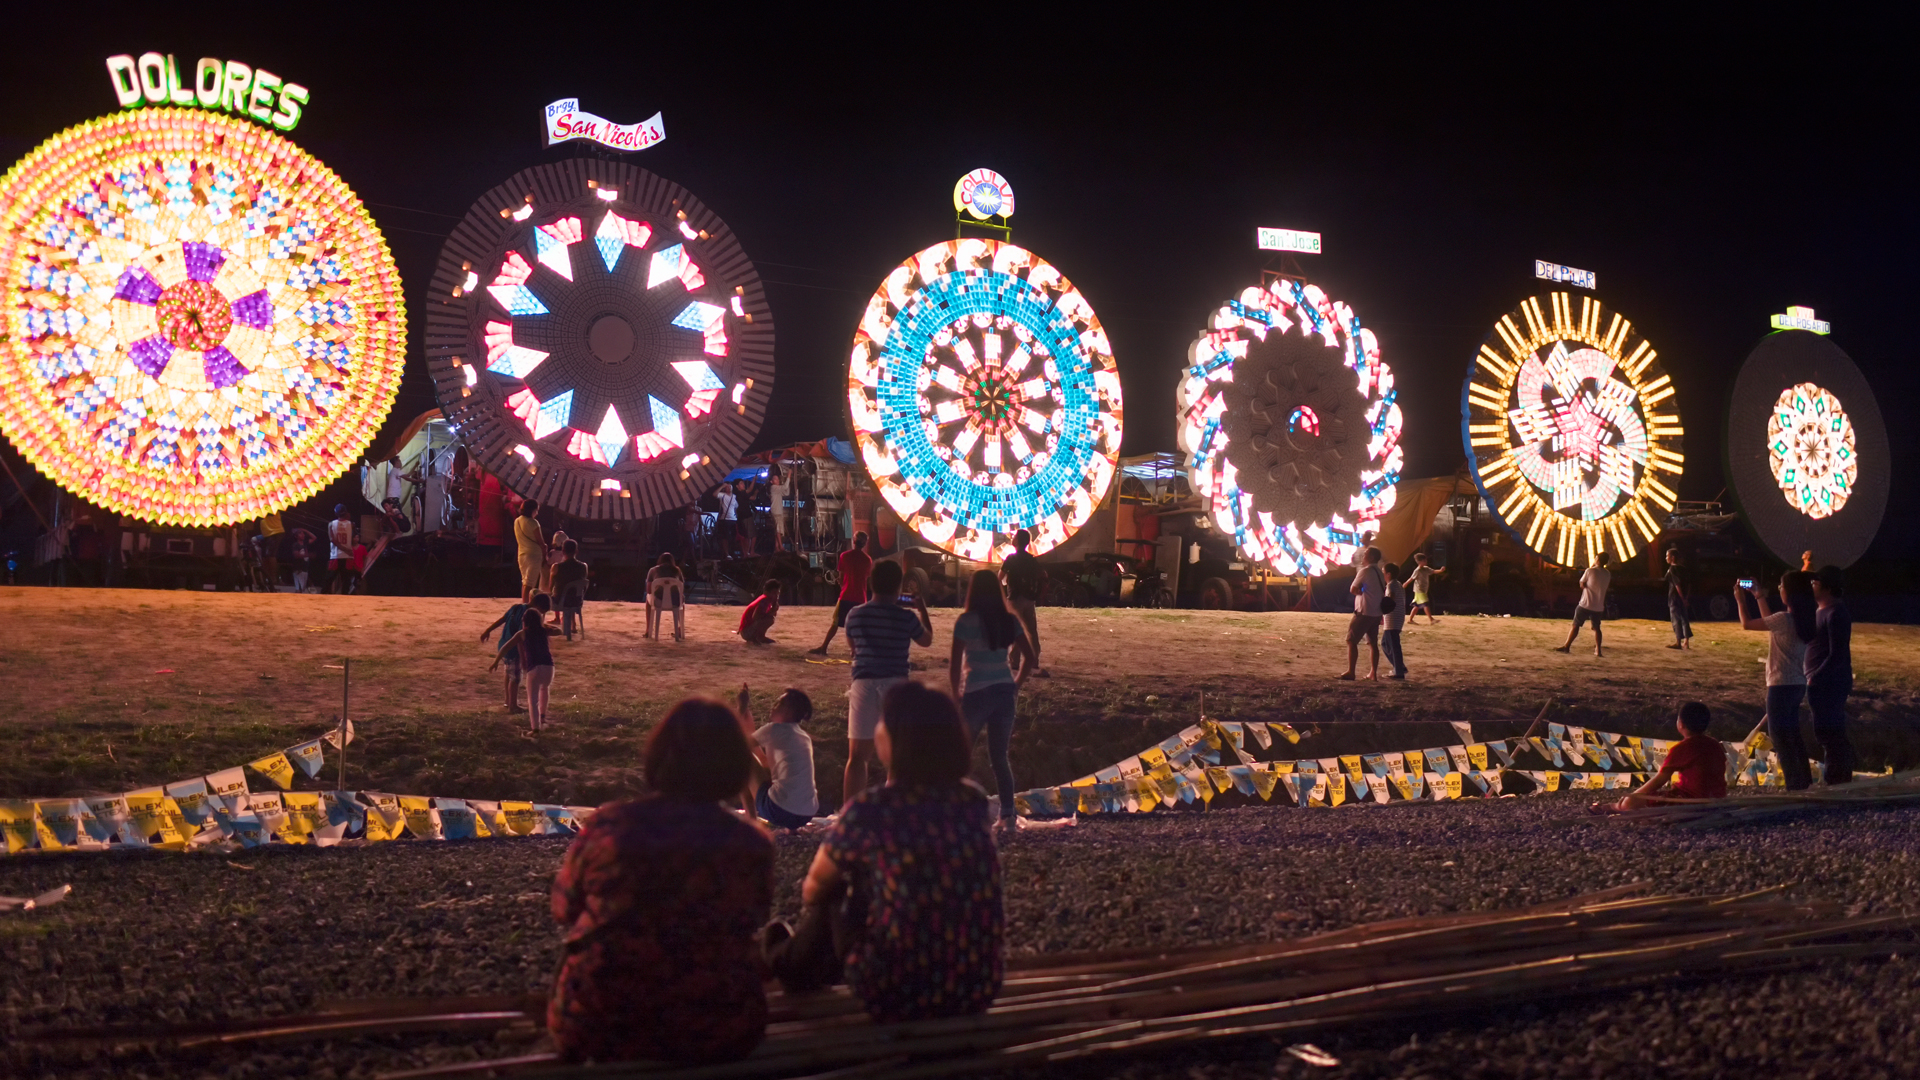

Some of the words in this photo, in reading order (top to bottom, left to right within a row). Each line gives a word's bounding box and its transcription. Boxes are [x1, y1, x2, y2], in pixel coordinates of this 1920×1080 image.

[106, 52, 310, 131] DOLORES
[552, 113, 597, 141] San
[595, 122, 663, 149] Nicolas
[961, 169, 1014, 213] CALULUT
[1261, 230, 1284, 247] San
[1291, 233, 1320, 250] Jose
[1536, 261, 1558, 280] DEL
[1779, 314, 1796, 327] DEL
[1796, 318, 1830, 334] ROSARIO
